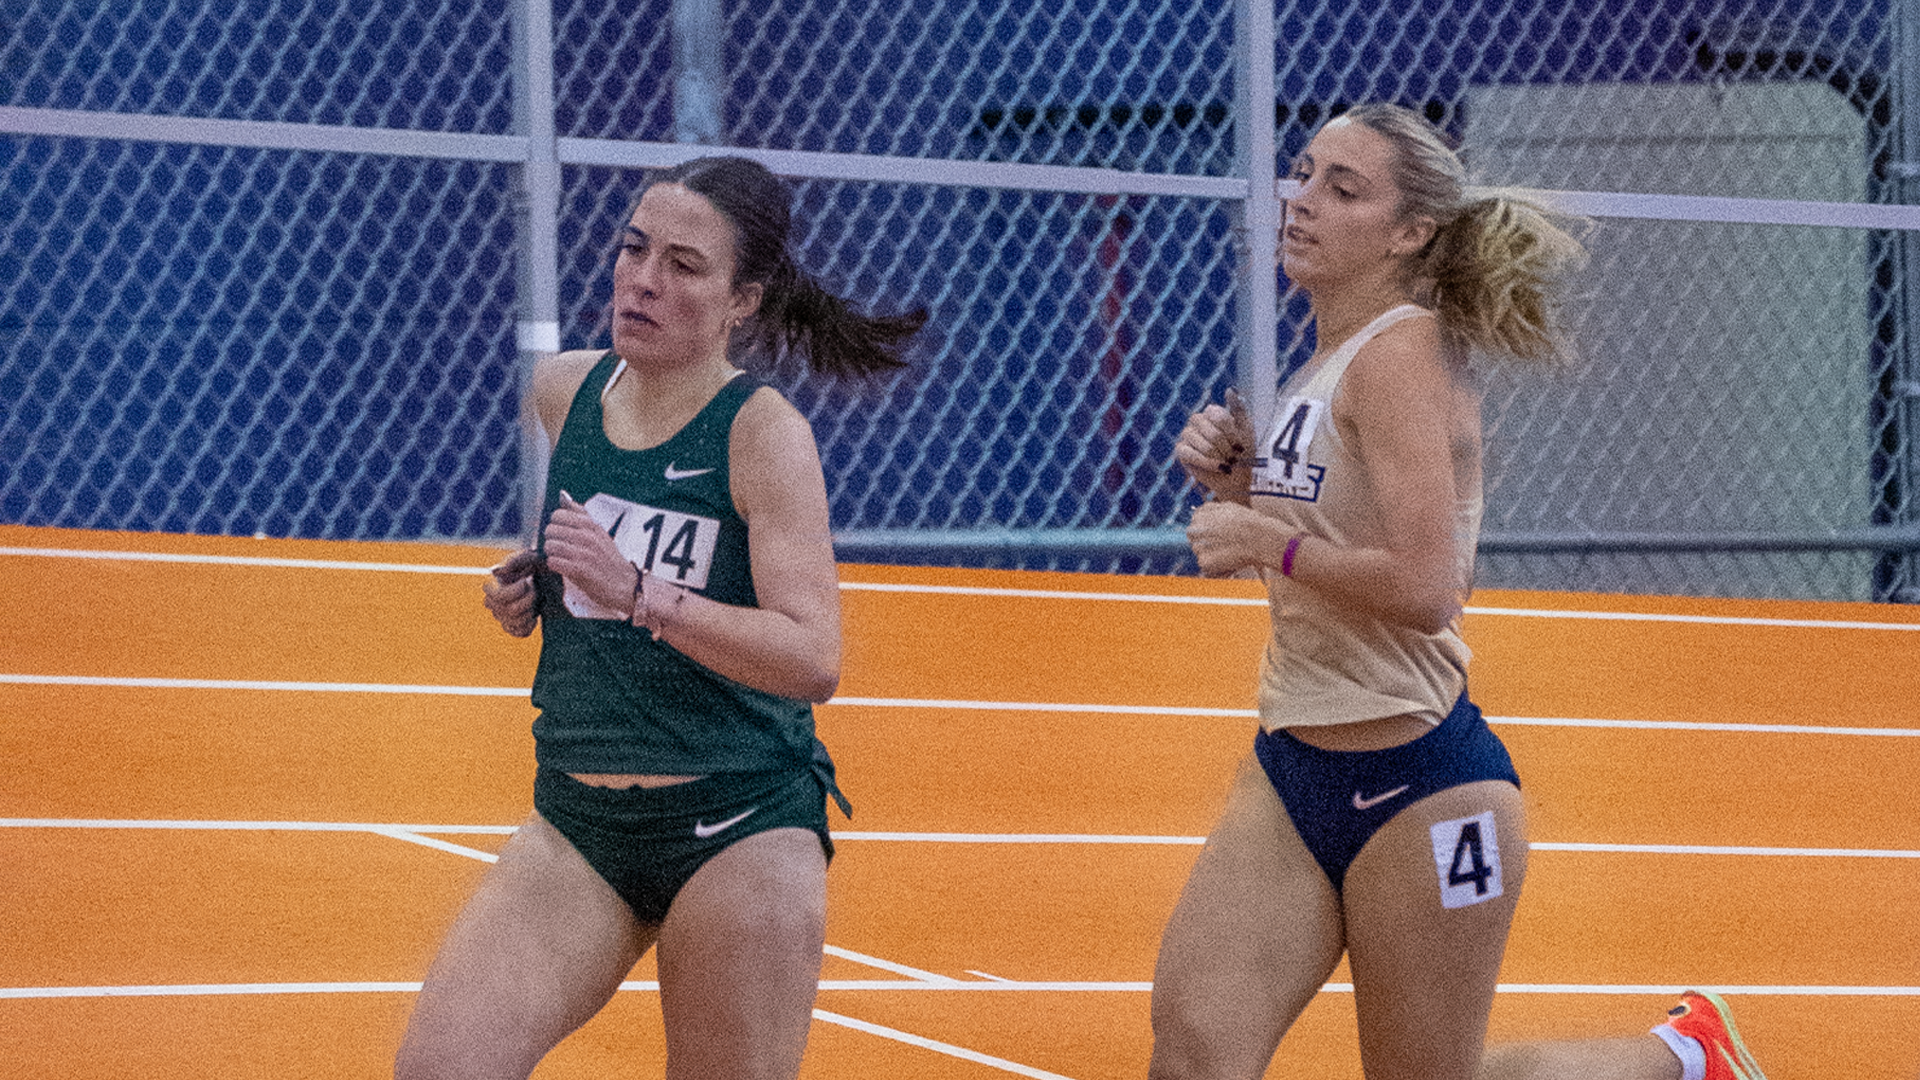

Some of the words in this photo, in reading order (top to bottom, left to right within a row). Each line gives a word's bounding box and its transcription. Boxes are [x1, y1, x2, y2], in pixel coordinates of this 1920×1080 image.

[1272, 404, 1311, 479] 4
[643, 513, 700, 580] 14
[1448, 822, 1492, 896] 4
